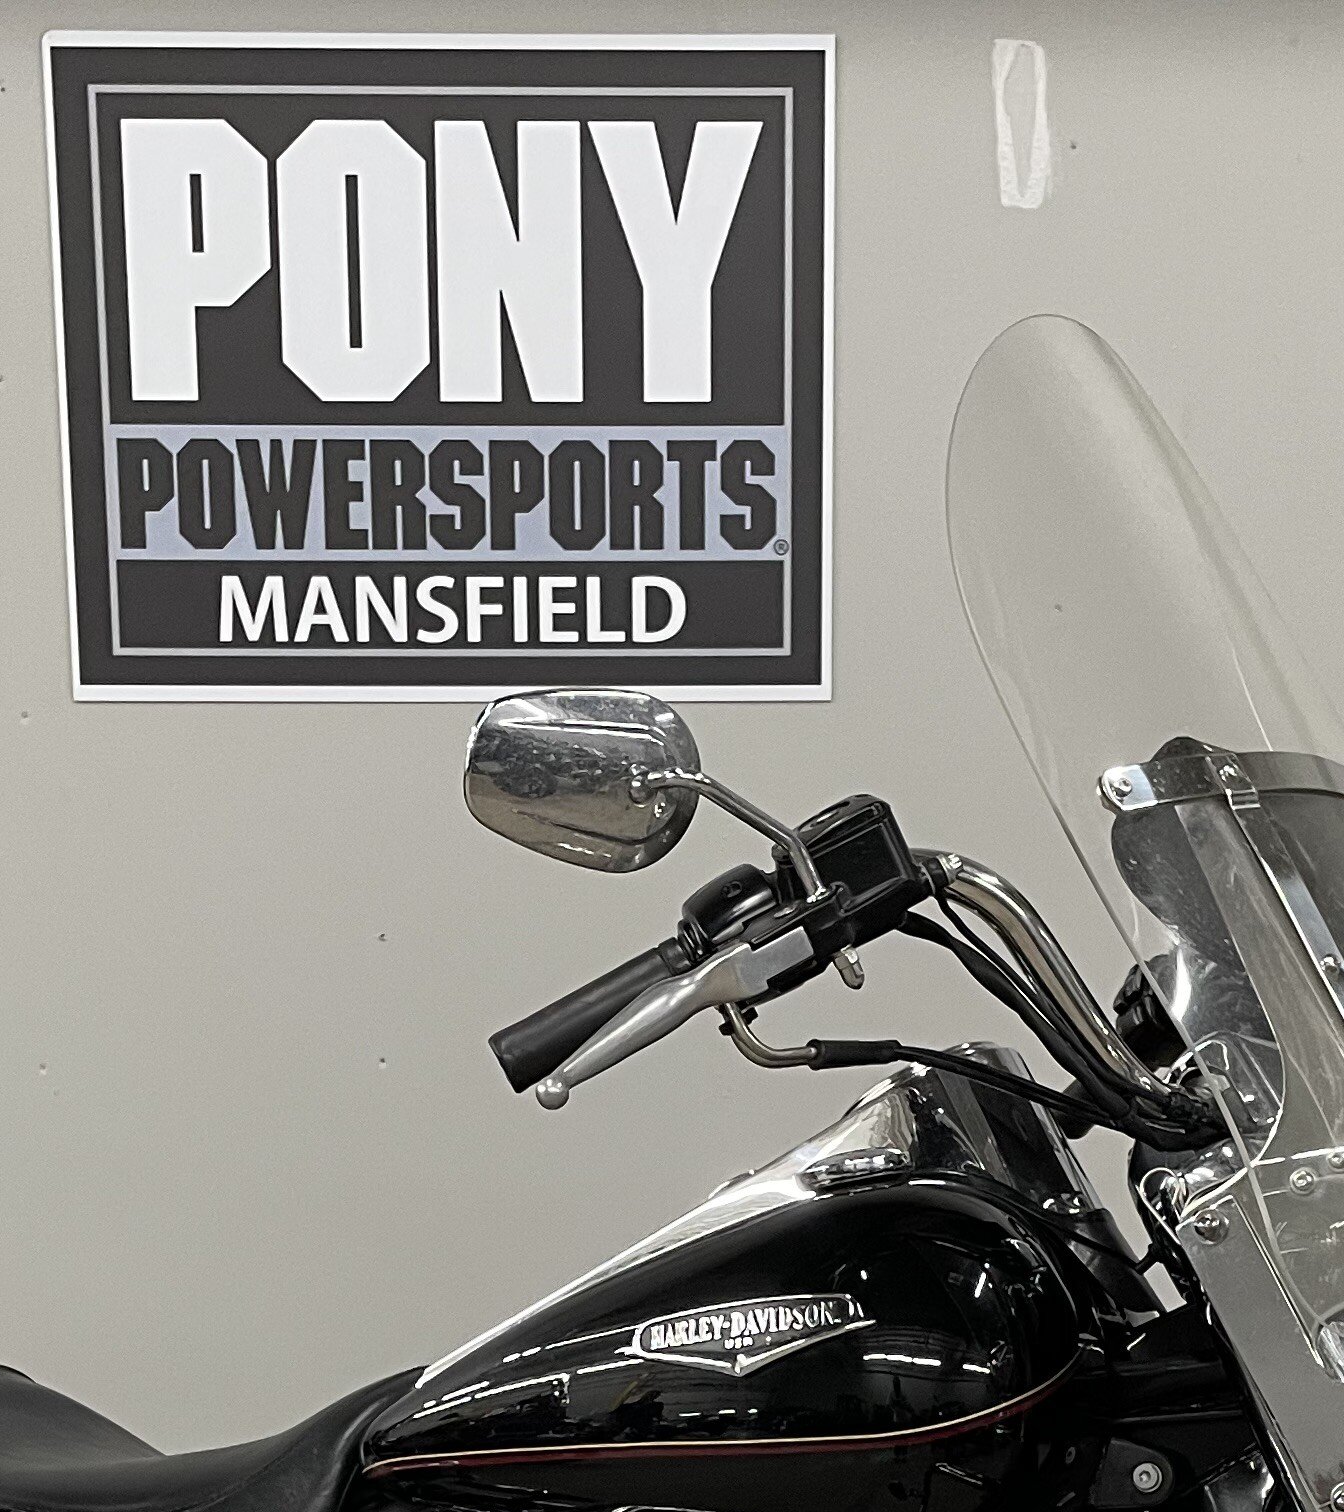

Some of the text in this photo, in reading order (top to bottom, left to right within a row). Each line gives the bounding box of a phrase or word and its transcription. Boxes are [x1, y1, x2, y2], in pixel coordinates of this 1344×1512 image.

[120, 118, 764, 403] PONY
[116, 438, 778, 552] POWERSPORTS
[219, 575, 688, 645] MANSFIELD
[650, 1300, 842, 1351] HARLEY-DAVIDSON
